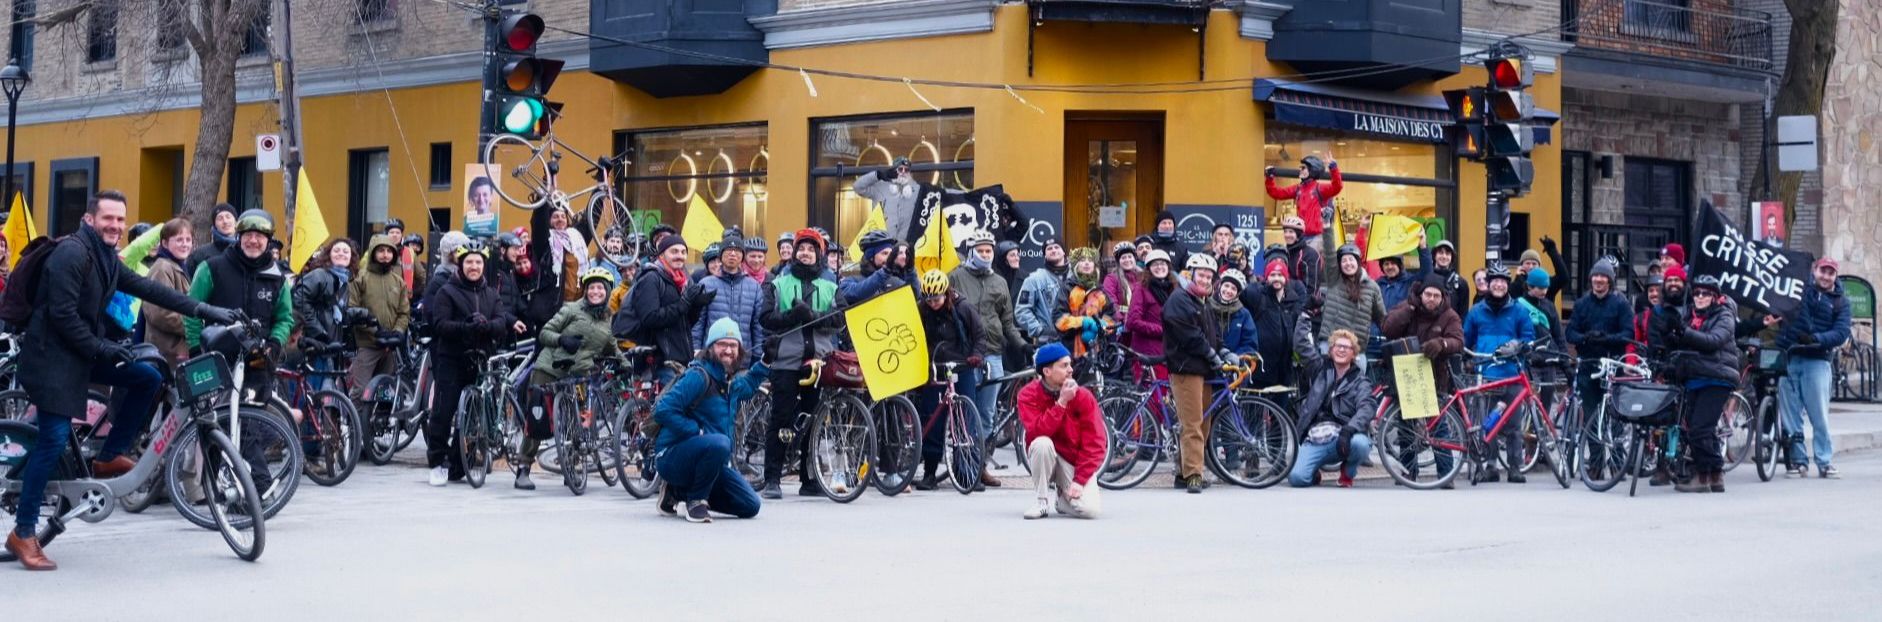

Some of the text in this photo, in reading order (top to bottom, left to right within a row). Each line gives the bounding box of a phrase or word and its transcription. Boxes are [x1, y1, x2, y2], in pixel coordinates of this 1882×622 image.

[1354, 113, 1369, 131] LA
[1370, 116, 1409, 136] MAISON
[1410, 121, 1429, 138] DES
[1237, 214, 1258, 227] 1251
[1701, 234, 1804, 301] CRITIQUE
[1725, 224, 1789, 274] MASSE
[1720, 271, 1771, 308] MTL
